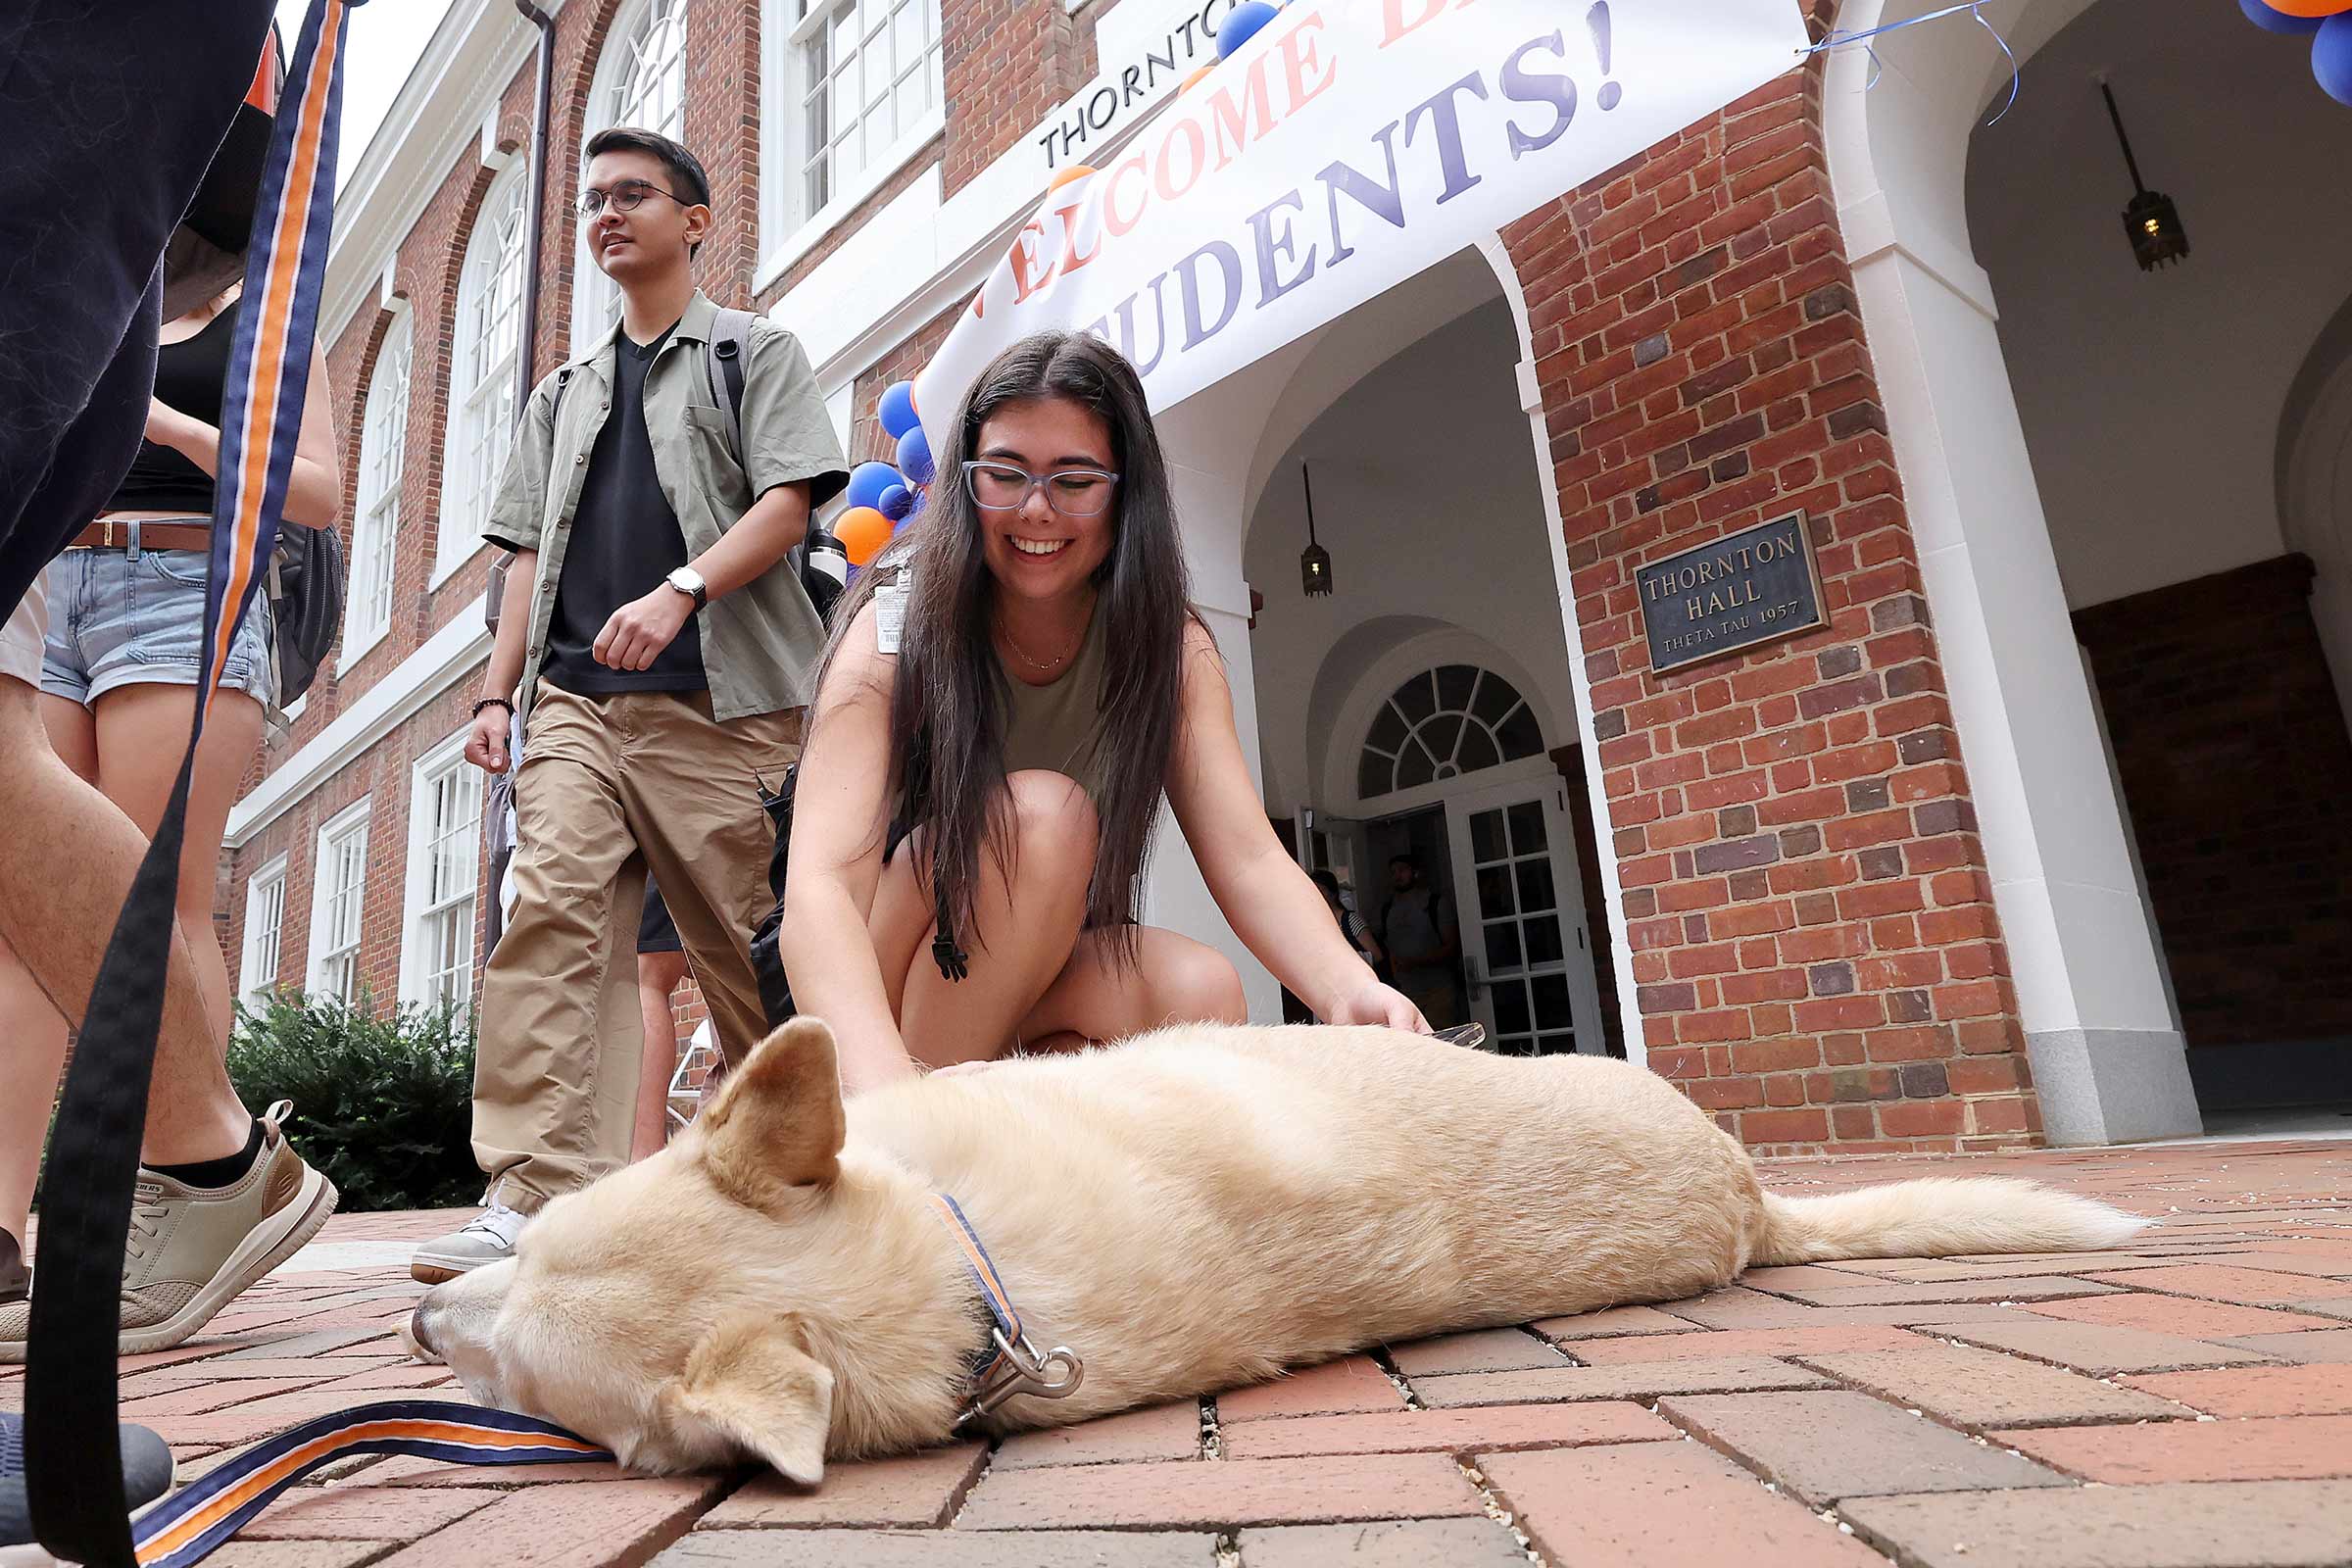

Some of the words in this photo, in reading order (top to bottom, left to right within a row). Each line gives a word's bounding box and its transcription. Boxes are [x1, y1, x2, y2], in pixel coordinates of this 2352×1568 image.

[973, 10, 1337, 319] ELCOME
[1082, 0, 1623, 379] UDENTS!
[1645, 532, 1796, 601] THORNTON
[1686, 579, 1761, 621] HALL
[1663, 627, 1715, 654] THETA
[1720, 615, 1750, 635] TAU
[1759, 600, 1799, 624] 1957
